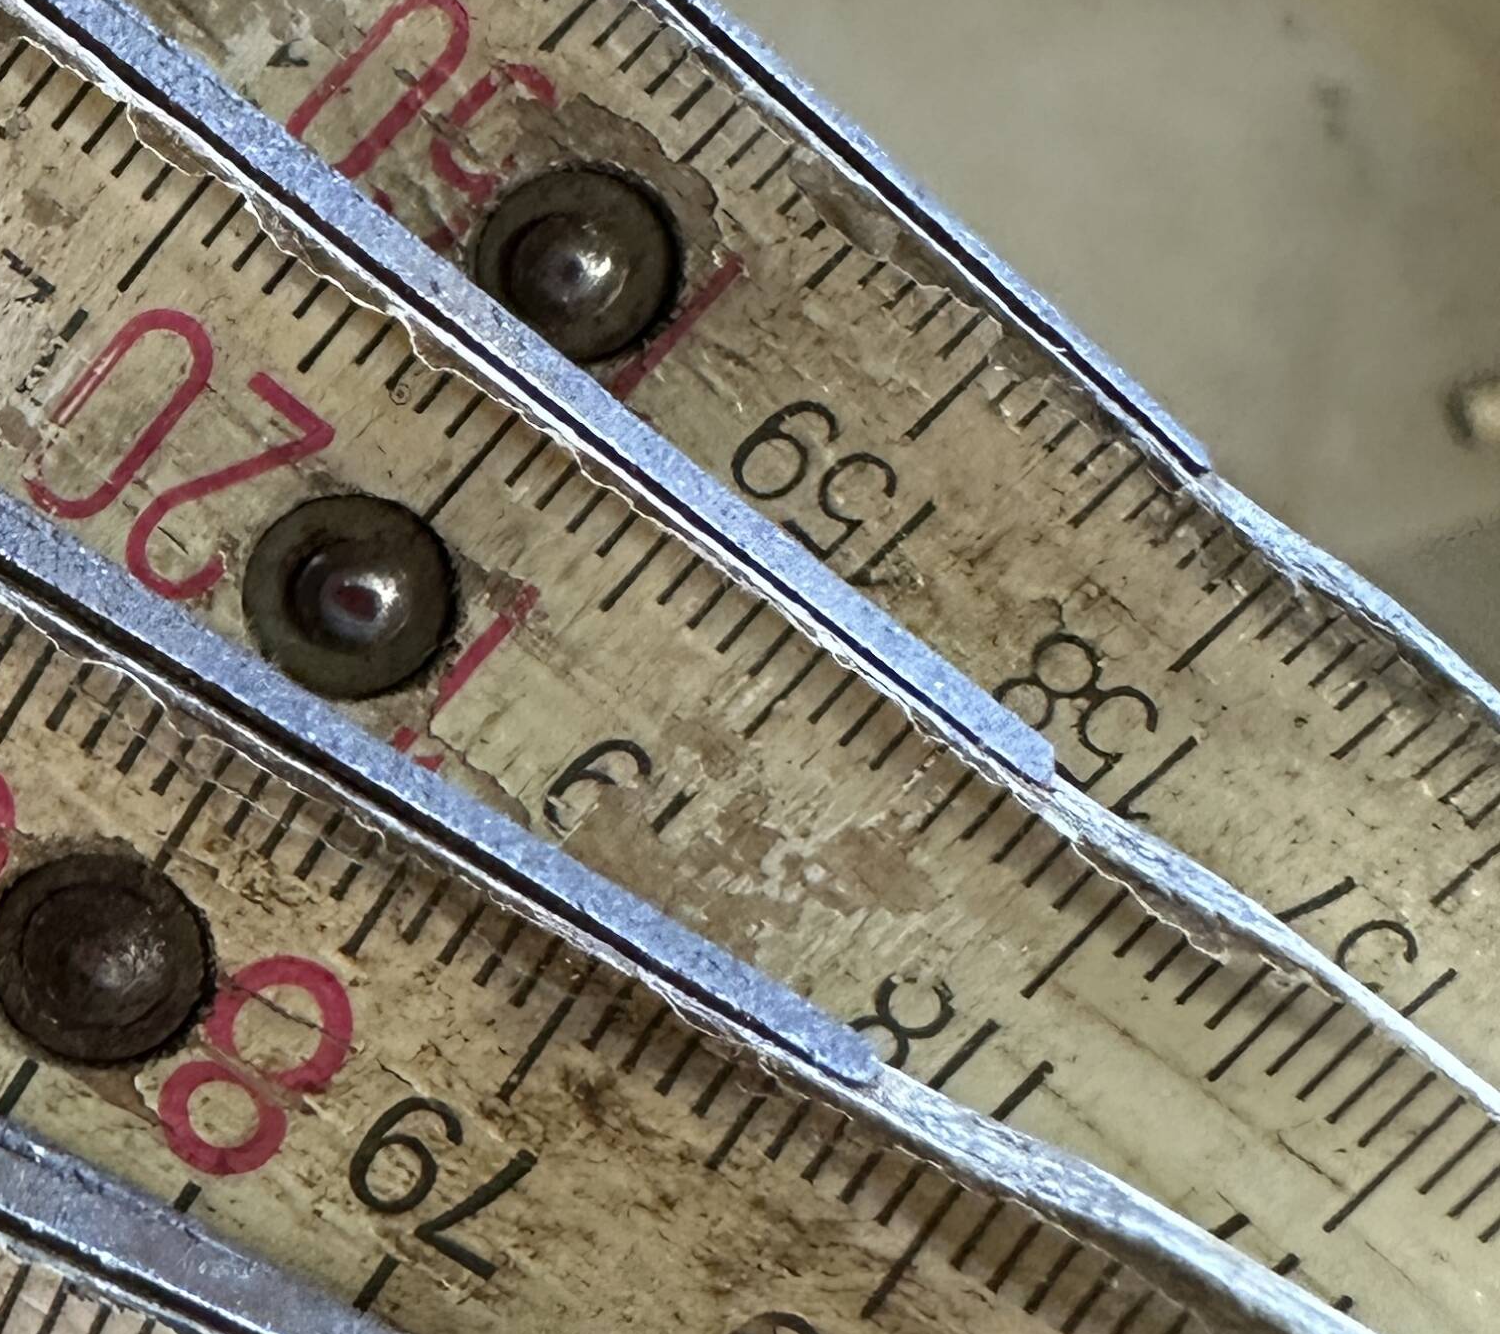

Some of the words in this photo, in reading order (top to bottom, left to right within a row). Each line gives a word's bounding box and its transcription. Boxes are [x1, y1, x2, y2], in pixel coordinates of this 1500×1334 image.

[730, 399, 937, 587] 159
[993, 632, 1198, 819] 158
[348, 1095, 539, 1281] 79
